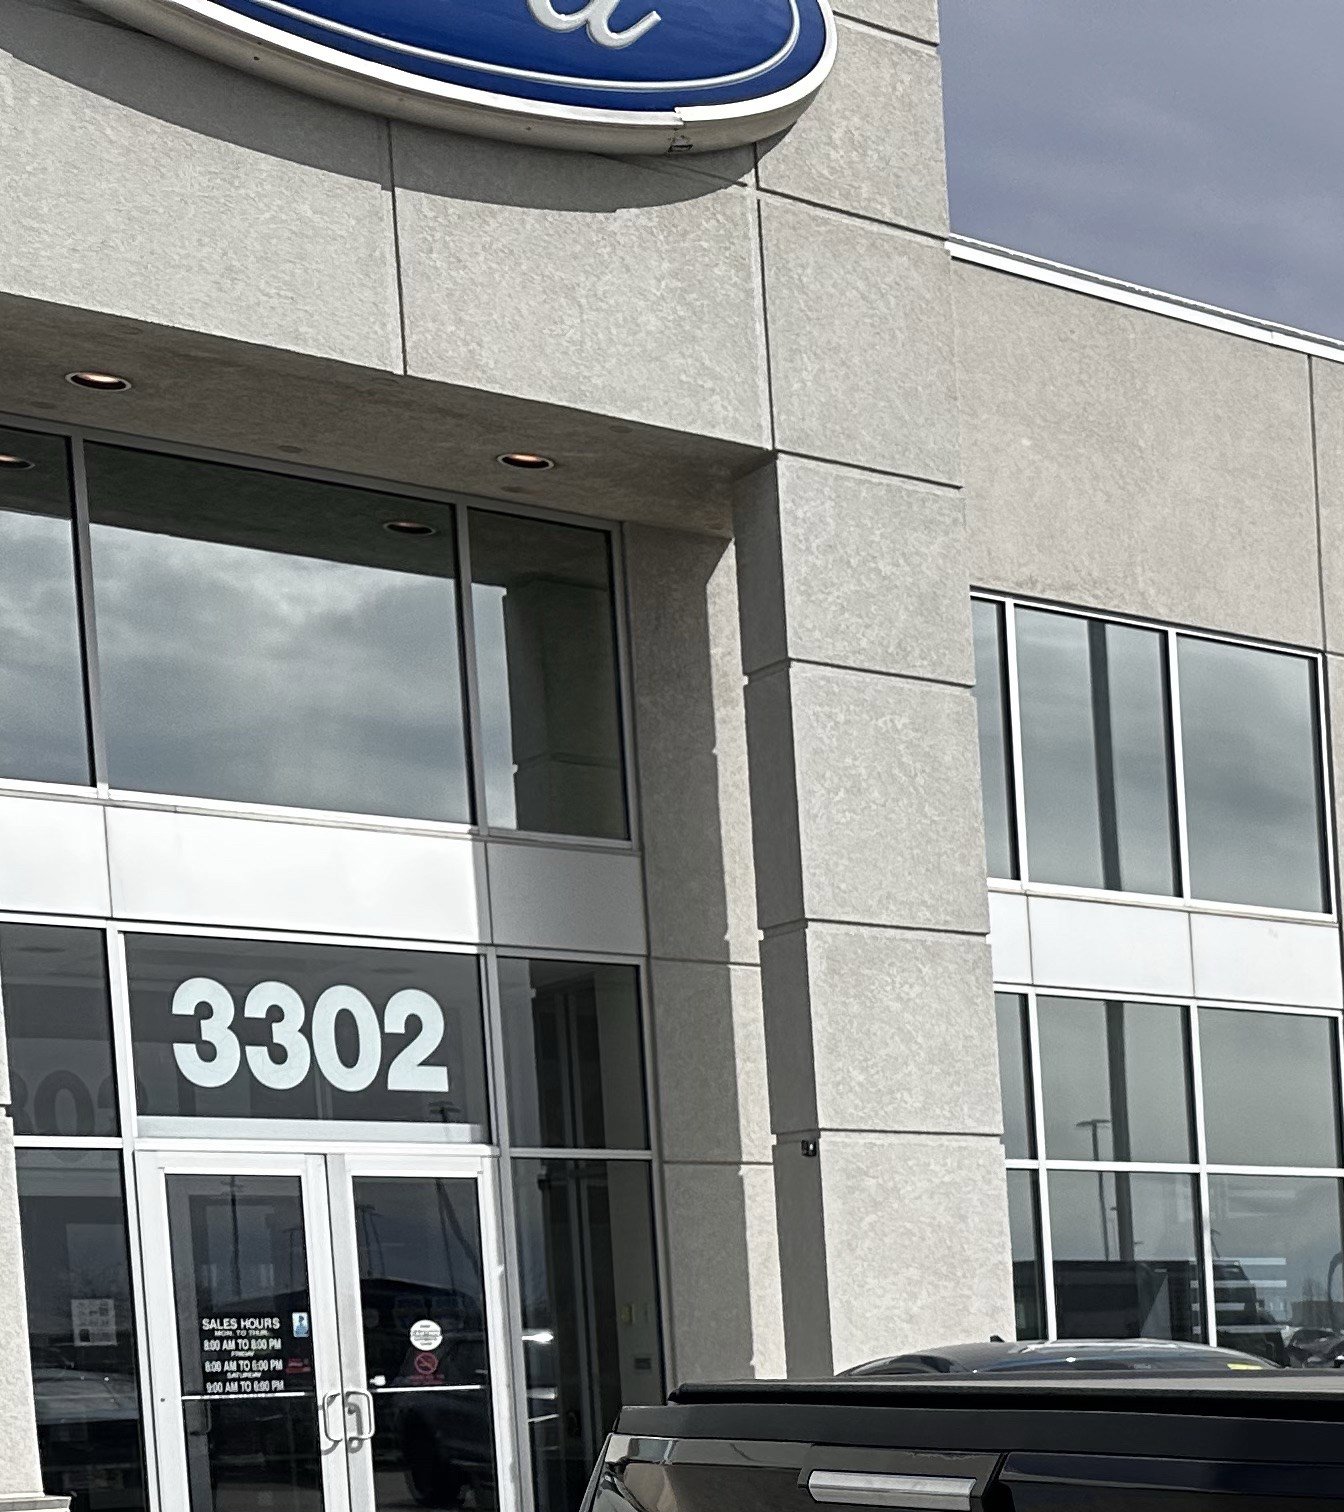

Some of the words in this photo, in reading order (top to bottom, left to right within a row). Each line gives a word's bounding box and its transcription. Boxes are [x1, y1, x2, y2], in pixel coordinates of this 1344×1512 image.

[172, 982, 449, 1092] 3302
[202, 1318, 238, 1330] SALES
[240, 1317, 280, 1329] HOURS
[222, 1339, 236, 1350] AM
[237, 1339, 249, 1350] TO
[269, 1338, 282, 1350] PM
[224, 1360, 237, 1371] AM
[238, 1360, 250, 1371] TO
[270, 1359, 283, 1371] PM
[225, 1381, 238, 1392] AM
[240, 1381, 252, 1392] TO
[272, 1380, 285, 1391] PM
